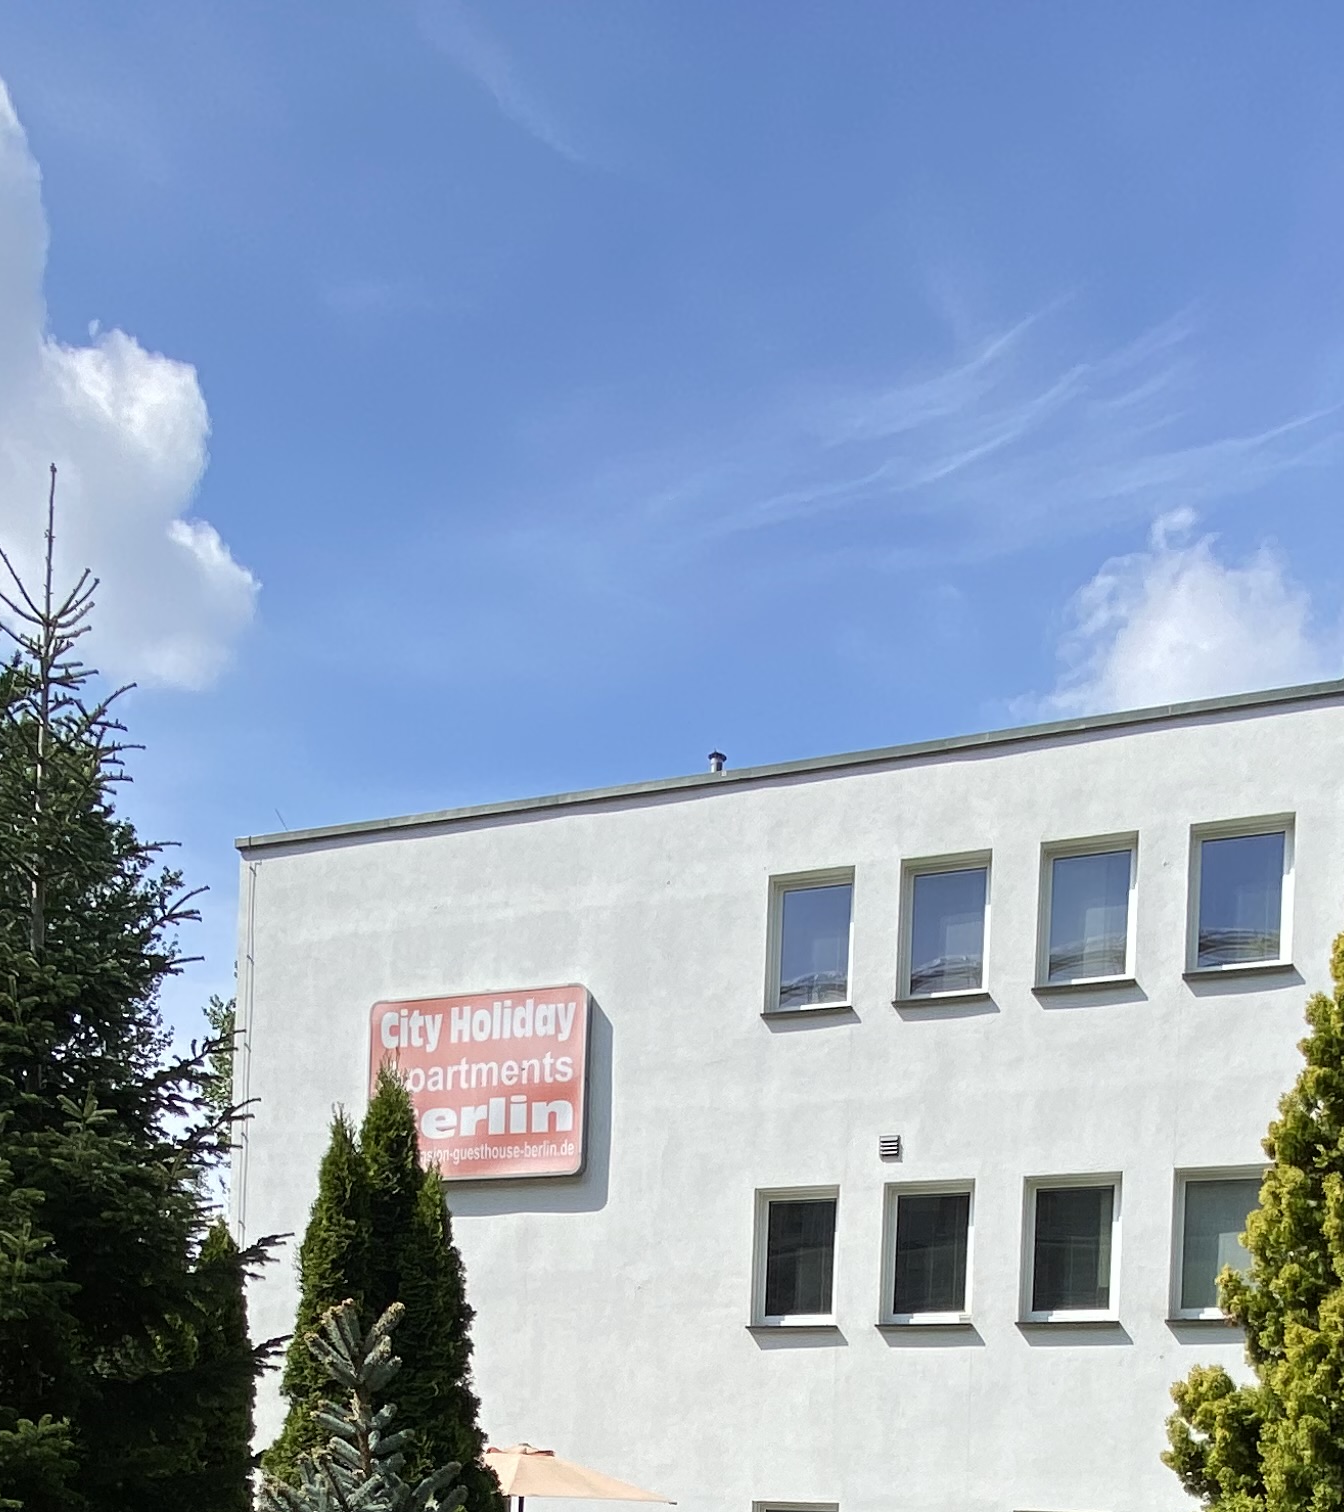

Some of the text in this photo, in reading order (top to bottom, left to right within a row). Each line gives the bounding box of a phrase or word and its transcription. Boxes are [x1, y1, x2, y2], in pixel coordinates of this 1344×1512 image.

[380, 999, 577, 1052] City Holiday
[390, 1051, 573, 1093] partments
[415, 1095, 573, 1139] erlin
